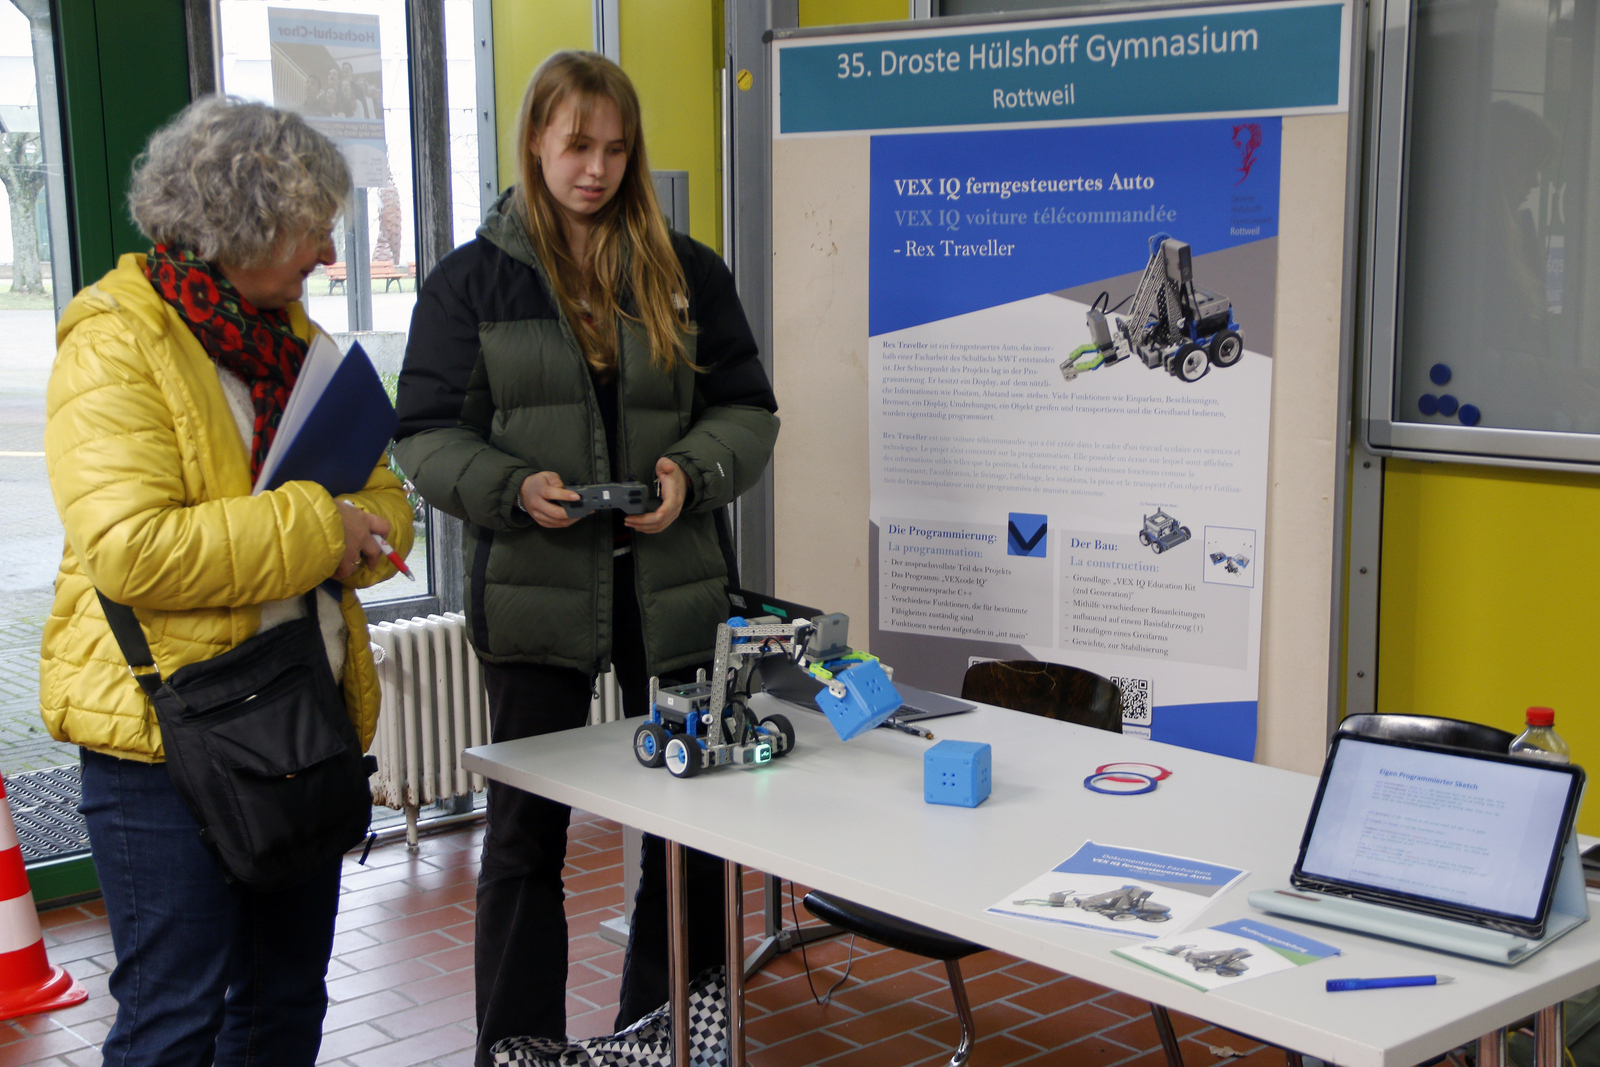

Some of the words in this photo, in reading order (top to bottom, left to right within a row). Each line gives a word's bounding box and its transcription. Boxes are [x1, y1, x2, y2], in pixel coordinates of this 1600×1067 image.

[838, 53, 871, 78] 35.
[881, 49, 960, 75] Droste
[969, 35, 1080, 70] Hülshoff
[1086, 26, 1258, 67] Gymnasium
[993, 83, 1074, 108] Rottweil
[895, 179, 933, 195] VEX
[939, 178, 960, 200] IQ
[966, 177, 1102, 198] ferngesteuertes
[1109, 173, 1154, 190] Auto
[895, 210, 933, 226] VEX
[939, 210, 960, 231] IQ
[966, 209, 1027, 224] voiture
[1034, 205, 1177, 224] télécommandée
[1230, 226, 1260, 236] Rottweil
[906, 241, 935, 256] Rex
[940, 239, 1015, 256] Traveller
[889, 524, 906, 534] Die
[888, 541, 899, 551] La
[1071, 537, 1090, 548] Der
[1070, 556, 1082, 566] La
[1379, 768, 1398, 777] Eigen
[1398, 771, 1453, 787] Programmierter
[1455, 778, 1478, 790] Sketch
[1102, 854, 1166, 869] Dokumentation
